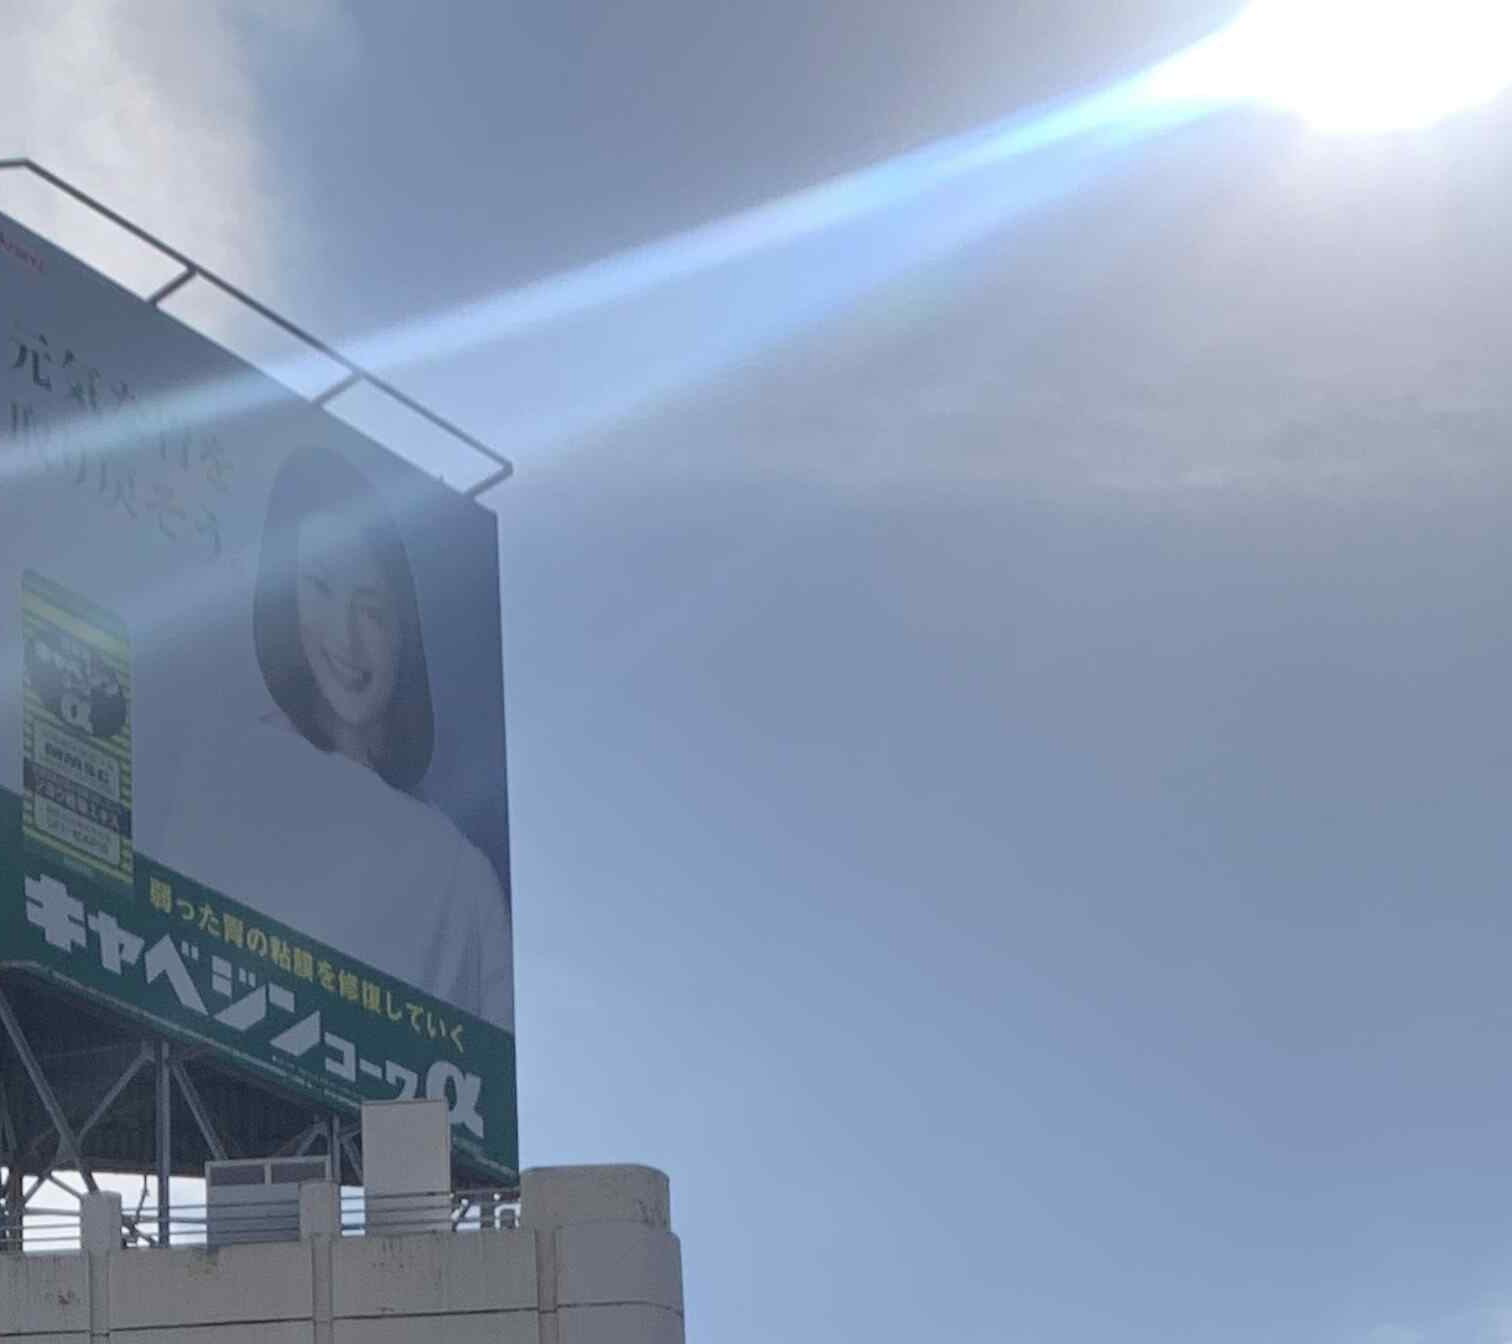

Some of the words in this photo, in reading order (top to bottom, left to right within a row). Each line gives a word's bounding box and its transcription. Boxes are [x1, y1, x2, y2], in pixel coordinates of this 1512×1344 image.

[24, 873, 484, 1138] キャベジンコーワα
[150, 877, 465, 1054] 弱った胃の粘膜を修復していく
